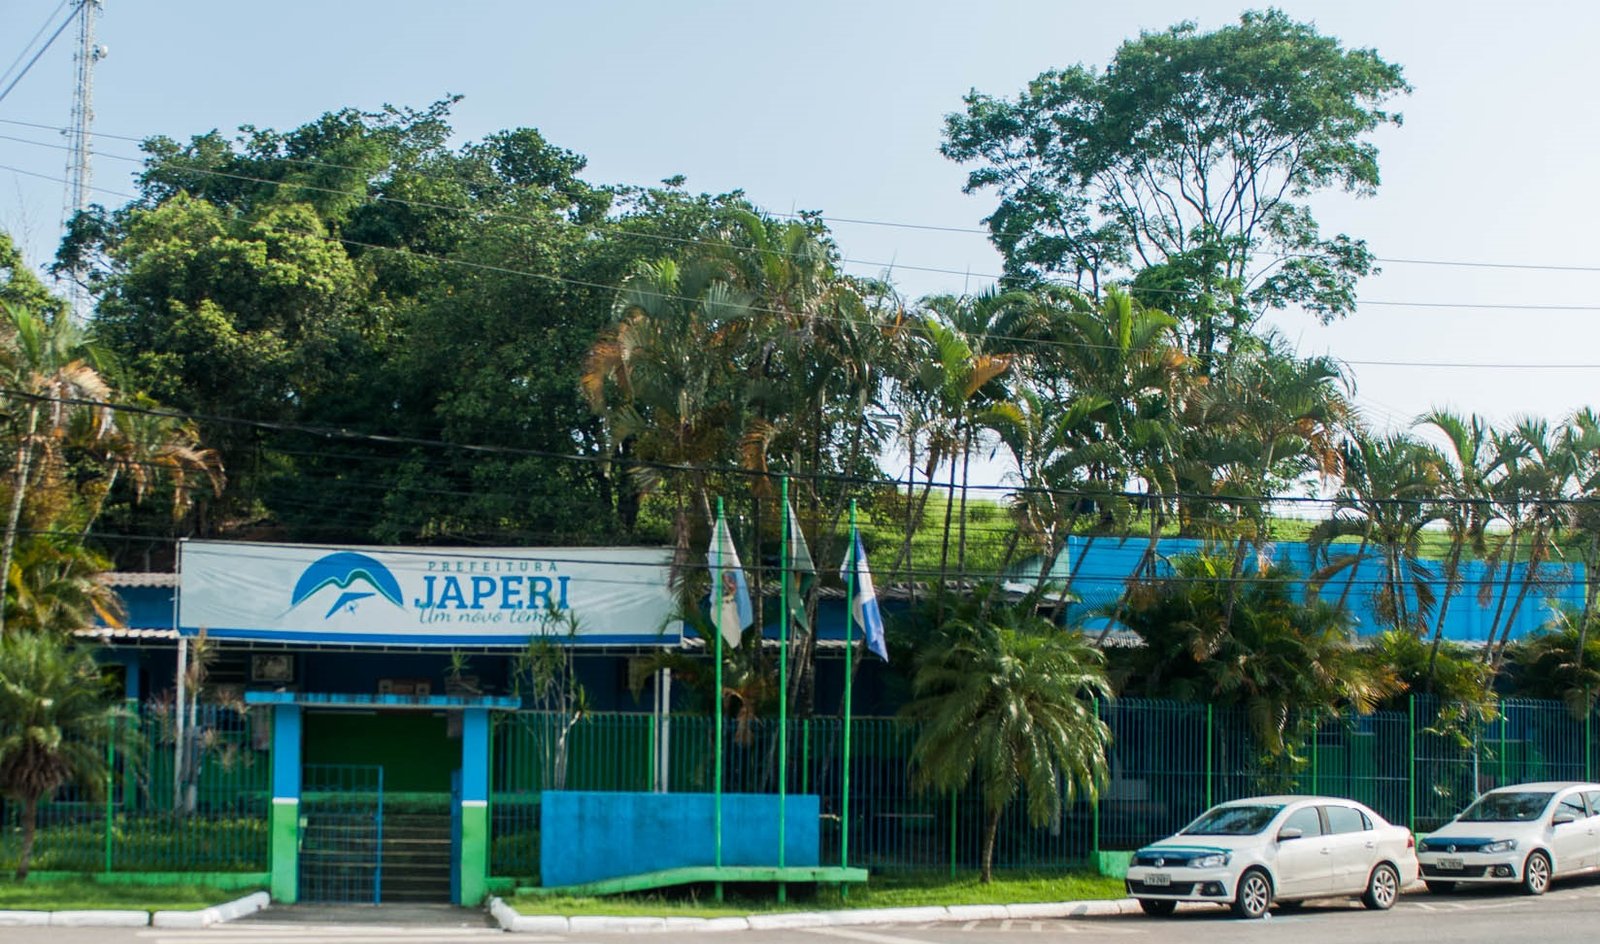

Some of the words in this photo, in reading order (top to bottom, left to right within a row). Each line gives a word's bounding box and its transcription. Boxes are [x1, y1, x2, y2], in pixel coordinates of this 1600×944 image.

[428, 561, 558, 572] PREFEITURA
[414, 575, 571, 610] JAPERI
[416, 602, 451, 625] Um
[458, 609, 502, 624] novo
